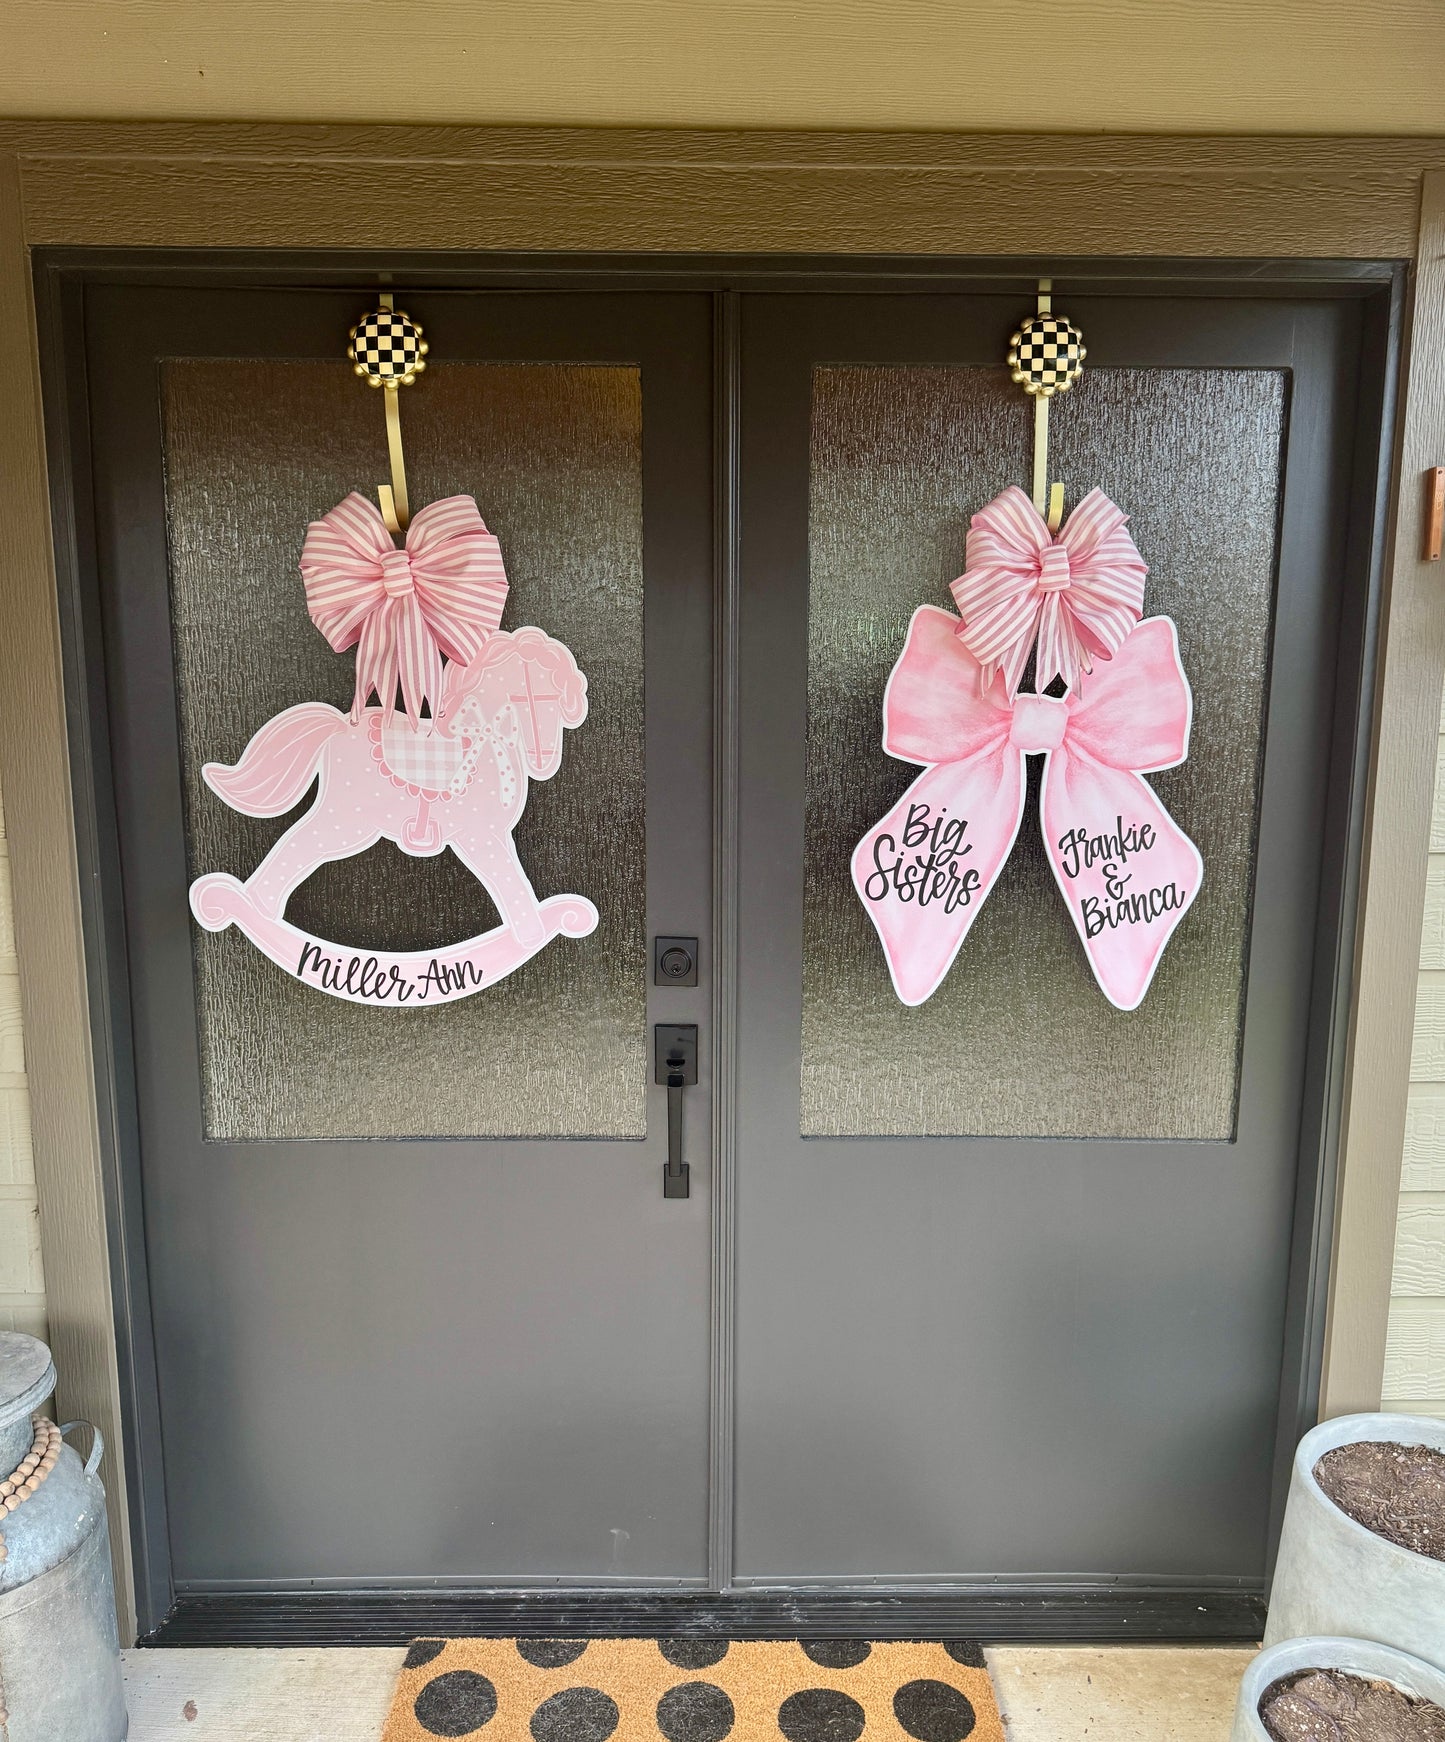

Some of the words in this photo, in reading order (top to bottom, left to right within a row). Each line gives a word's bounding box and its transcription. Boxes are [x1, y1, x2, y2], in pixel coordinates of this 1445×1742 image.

[902, 803, 973, 865] Big
[1058, 815, 1156, 878] Frankie
[864, 833, 982, 914] Sisters
[1102, 863, 1132, 899] &
[1080, 881, 1186, 939] Bianca
[297, 941, 415, 1001] Miller
[418, 958, 483, 1000] Ann
